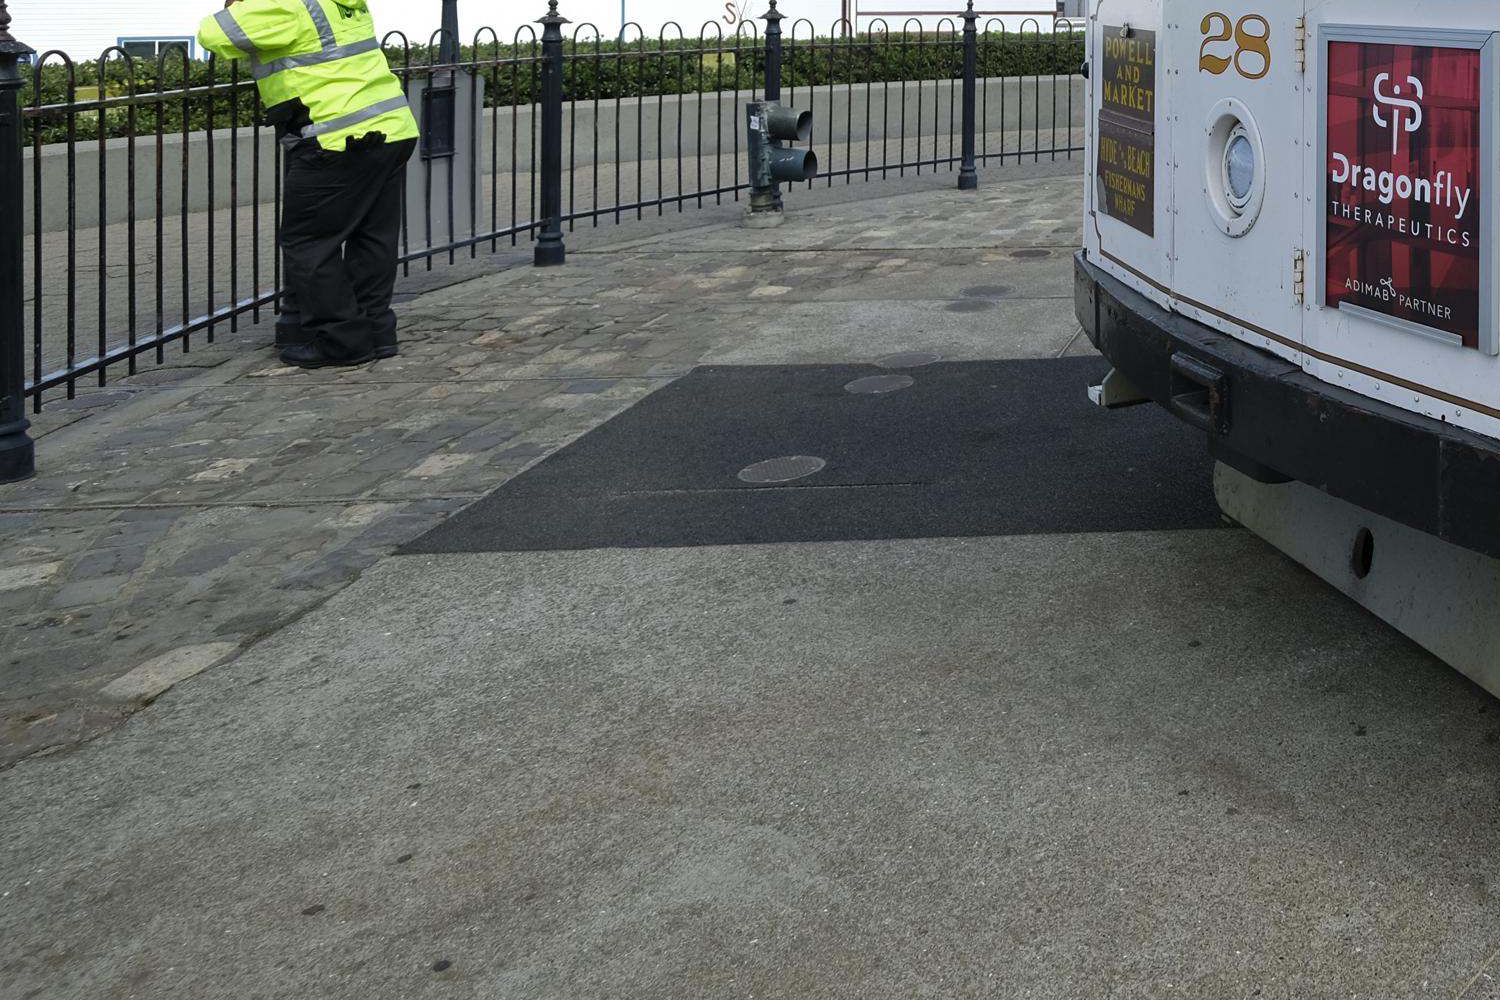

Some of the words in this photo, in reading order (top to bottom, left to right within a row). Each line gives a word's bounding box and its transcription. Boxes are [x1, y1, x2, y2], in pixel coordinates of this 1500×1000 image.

[1105, 36, 1152, 66] POWELL
[1199, 12, 1271, 79] 28
[1116, 64, 1140, 84] AND
[1104, 80, 1153, 113] MARKET
[1101, 136, 1118, 165] HYDE
[1127, 145, 1150, 178] BEACH
[1105, 170, 1145, 201] FISHERMANS
[1332, 152, 1471, 220] Dragonfly
[1114, 192, 1136, 217] WHARF
[1332, 200, 1471, 247] THERAPEUTICS
[1345, 278, 1389, 301] ADIMAB
[1399, 294, 1451, 320] PARTNER
